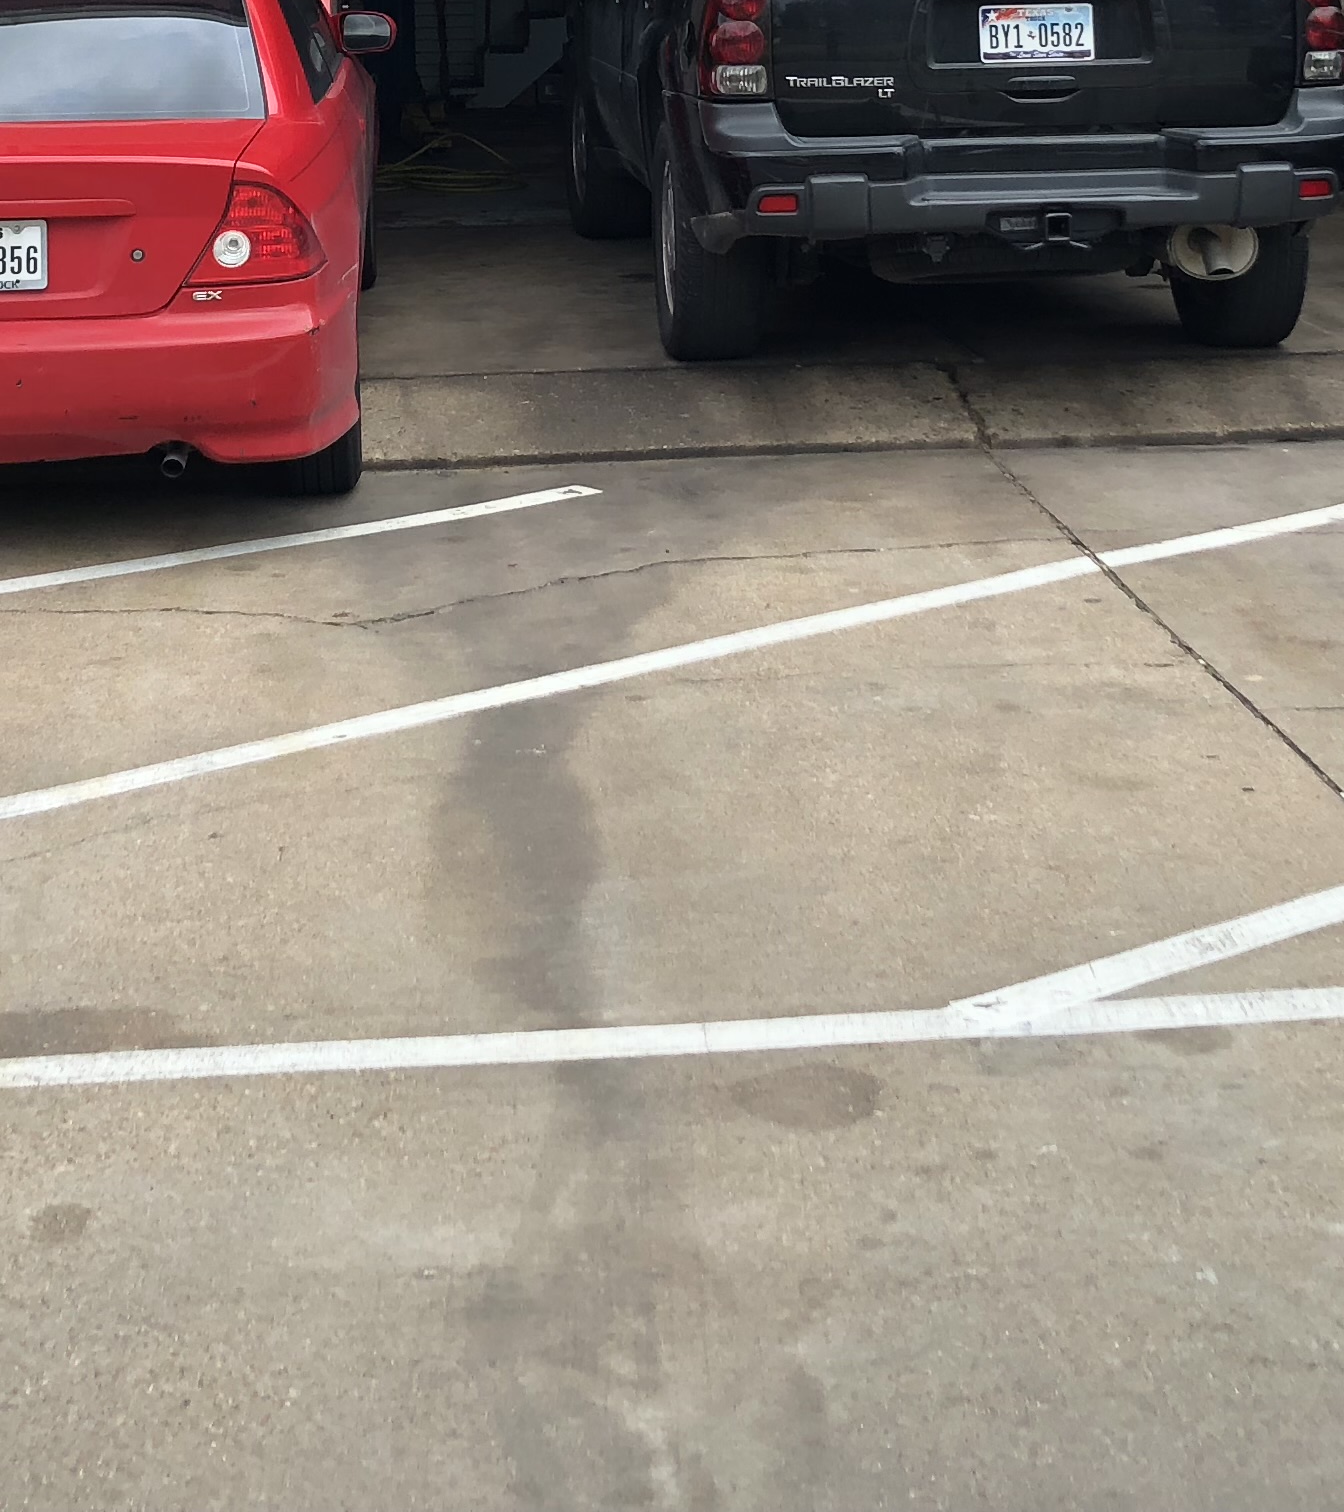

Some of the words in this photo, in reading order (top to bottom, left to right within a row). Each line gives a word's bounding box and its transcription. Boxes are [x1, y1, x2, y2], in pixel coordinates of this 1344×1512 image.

[1016, 8, 1055, 17] TEXAS
[785, 76, 894, 87] TRAILBLAZER
[878, 88, 895, 98] LT
[192, 290, 223, 301] EX
